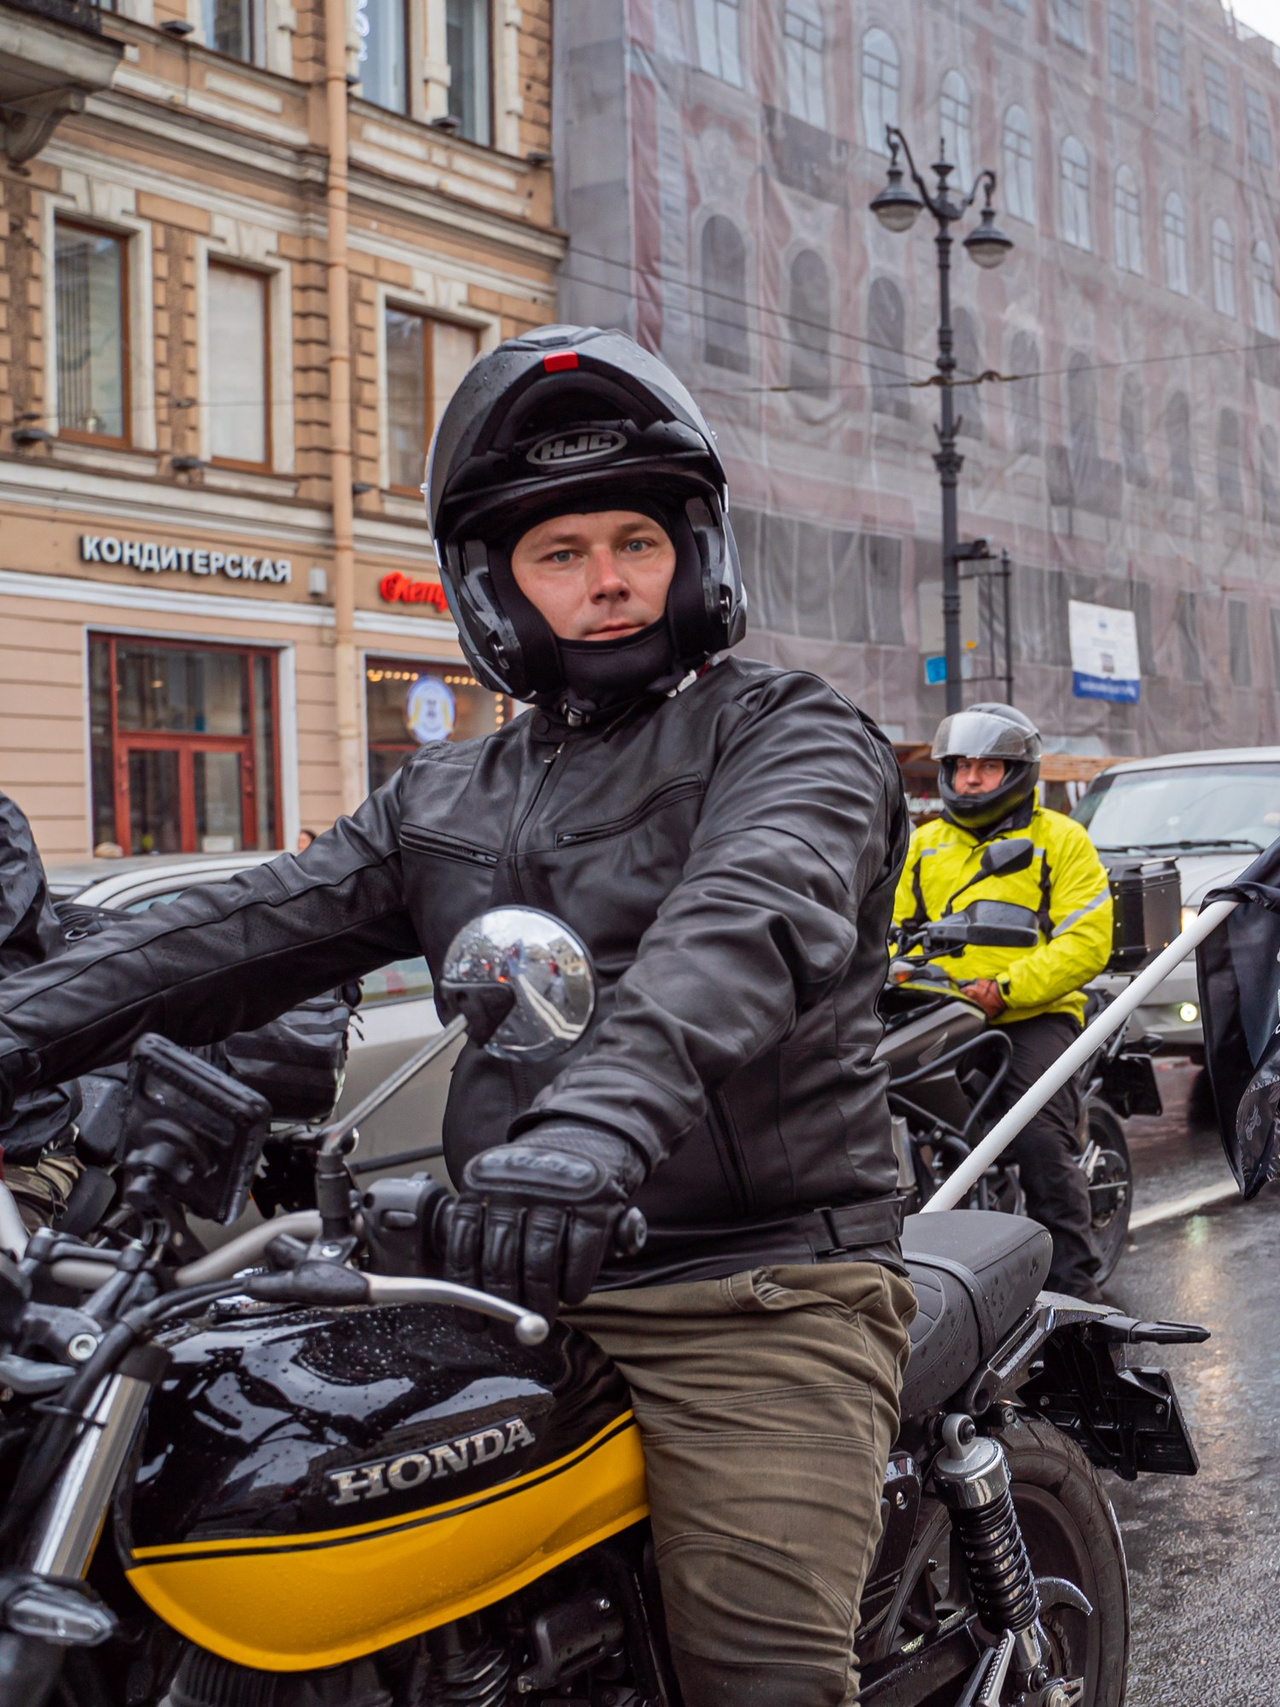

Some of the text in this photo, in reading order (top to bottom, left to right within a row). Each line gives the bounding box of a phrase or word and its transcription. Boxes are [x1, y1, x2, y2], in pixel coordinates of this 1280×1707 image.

[540, 434, 613, 461] HJC
[82, 534, 293, 585] КОНДИТЕРСКАЯ
[329, 1417, 536, 1507] HONDA
